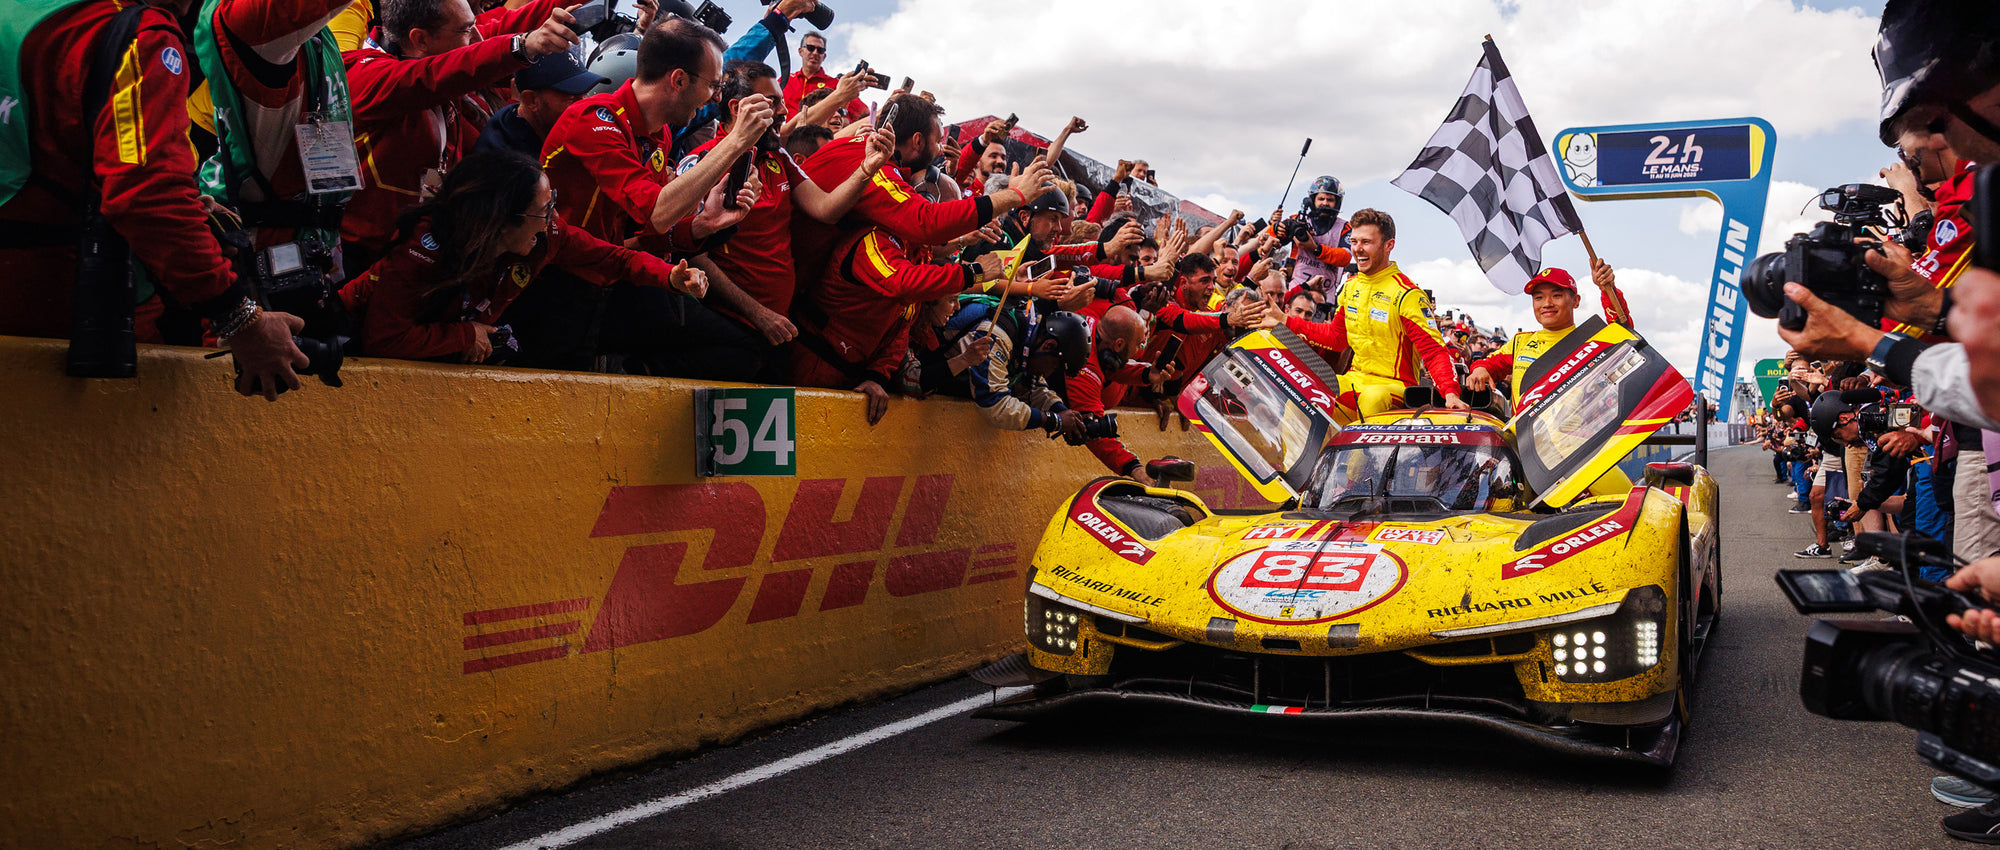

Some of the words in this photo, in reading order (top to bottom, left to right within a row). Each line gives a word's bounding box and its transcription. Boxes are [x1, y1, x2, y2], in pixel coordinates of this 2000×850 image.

[165, 50, 181, 71] hp
[599, 108, 614, 122] hp
[1644, 133, 1703, 166] 24h
[1642, 165, 1660, 175] LE
[1660, 163, 1700, 174] MANS
[1700, 217, 1750, 406] MICHELIN
[1268, 349, 1312, 389] ORLEN
[1548, 341, 1599, 383] ORLEN
[1767, 368, 1788, 376] ROLE
[712, 398, 795, 466] 54
[1344, 424, 1408, 432] CHARLES
[1410, 424, 1459, 432] POZZI
[1352, 432, 1462, 445] Ferrari
[1077, 512, 1125, 544] ORLEN
[1244, 527, 1300, 540] HY
[1379, 532, 1437, 544] CAR
[1384, 528, 1440, 537] HYPER
[1551, 520, 1624, 555] ORLEN
[579, 473, 972, 655] DHL
[1253, 554, 1367, 585] 83
[1050, 564, 1114, 594] RICHARD
[1111, 587, 1166, 608] MILLE
[1265, 590, 1328, 599] WEC
[1427, 597, 1532, 619] RICHARD
[1538, 582, 1609, 605] MILLE
